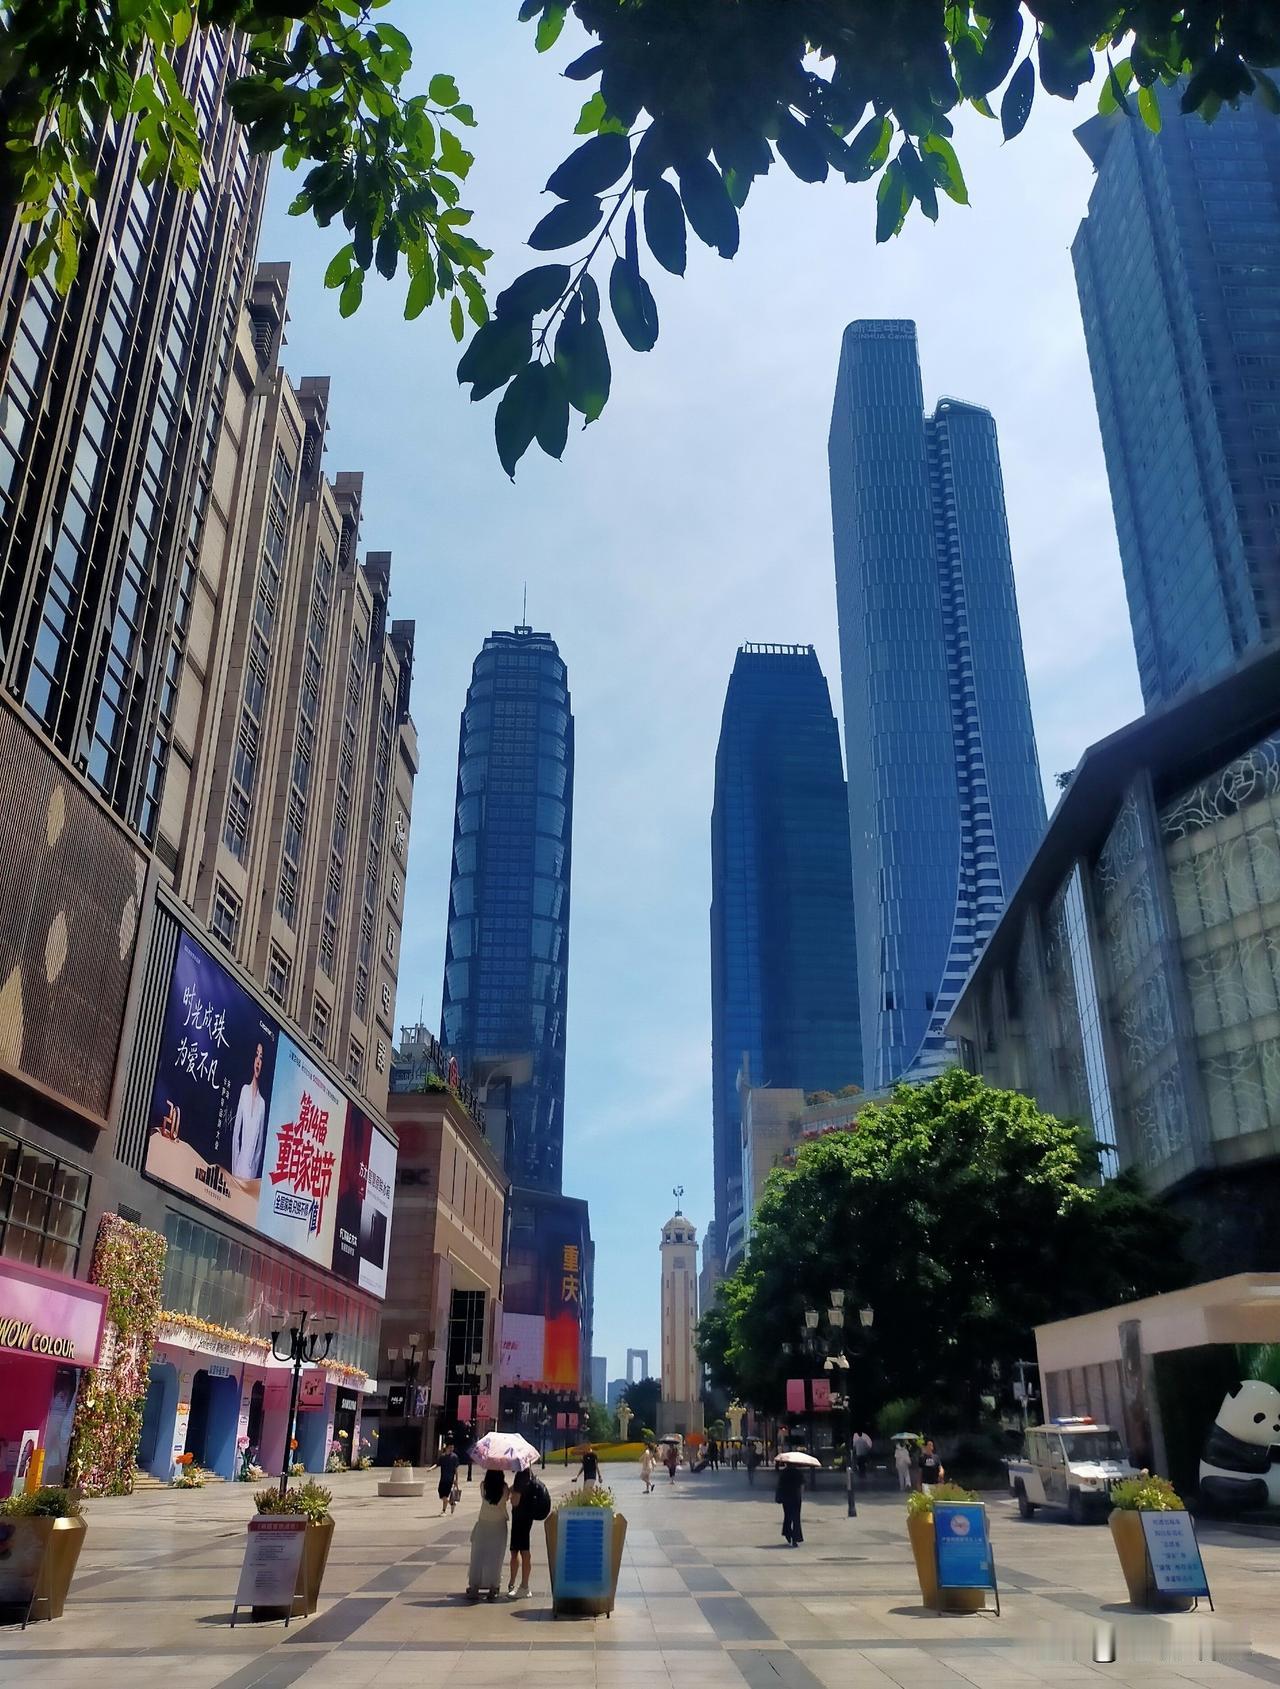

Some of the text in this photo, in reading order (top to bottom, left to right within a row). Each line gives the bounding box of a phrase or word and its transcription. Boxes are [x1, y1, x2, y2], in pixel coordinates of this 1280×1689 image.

[183, 983, 230, 1048] 时光成珠
[175, 1037, 219, 1090] 为爱不凡
[294, 1090, 329, 1145] 第14届
[269, 1122, 337, 1220] 重百家电节
[563, 1245, 578, 1302] 重庆
[0, 1317, 33, 1349] WOW
[32, 1332, 75, 1359] COLOUR
